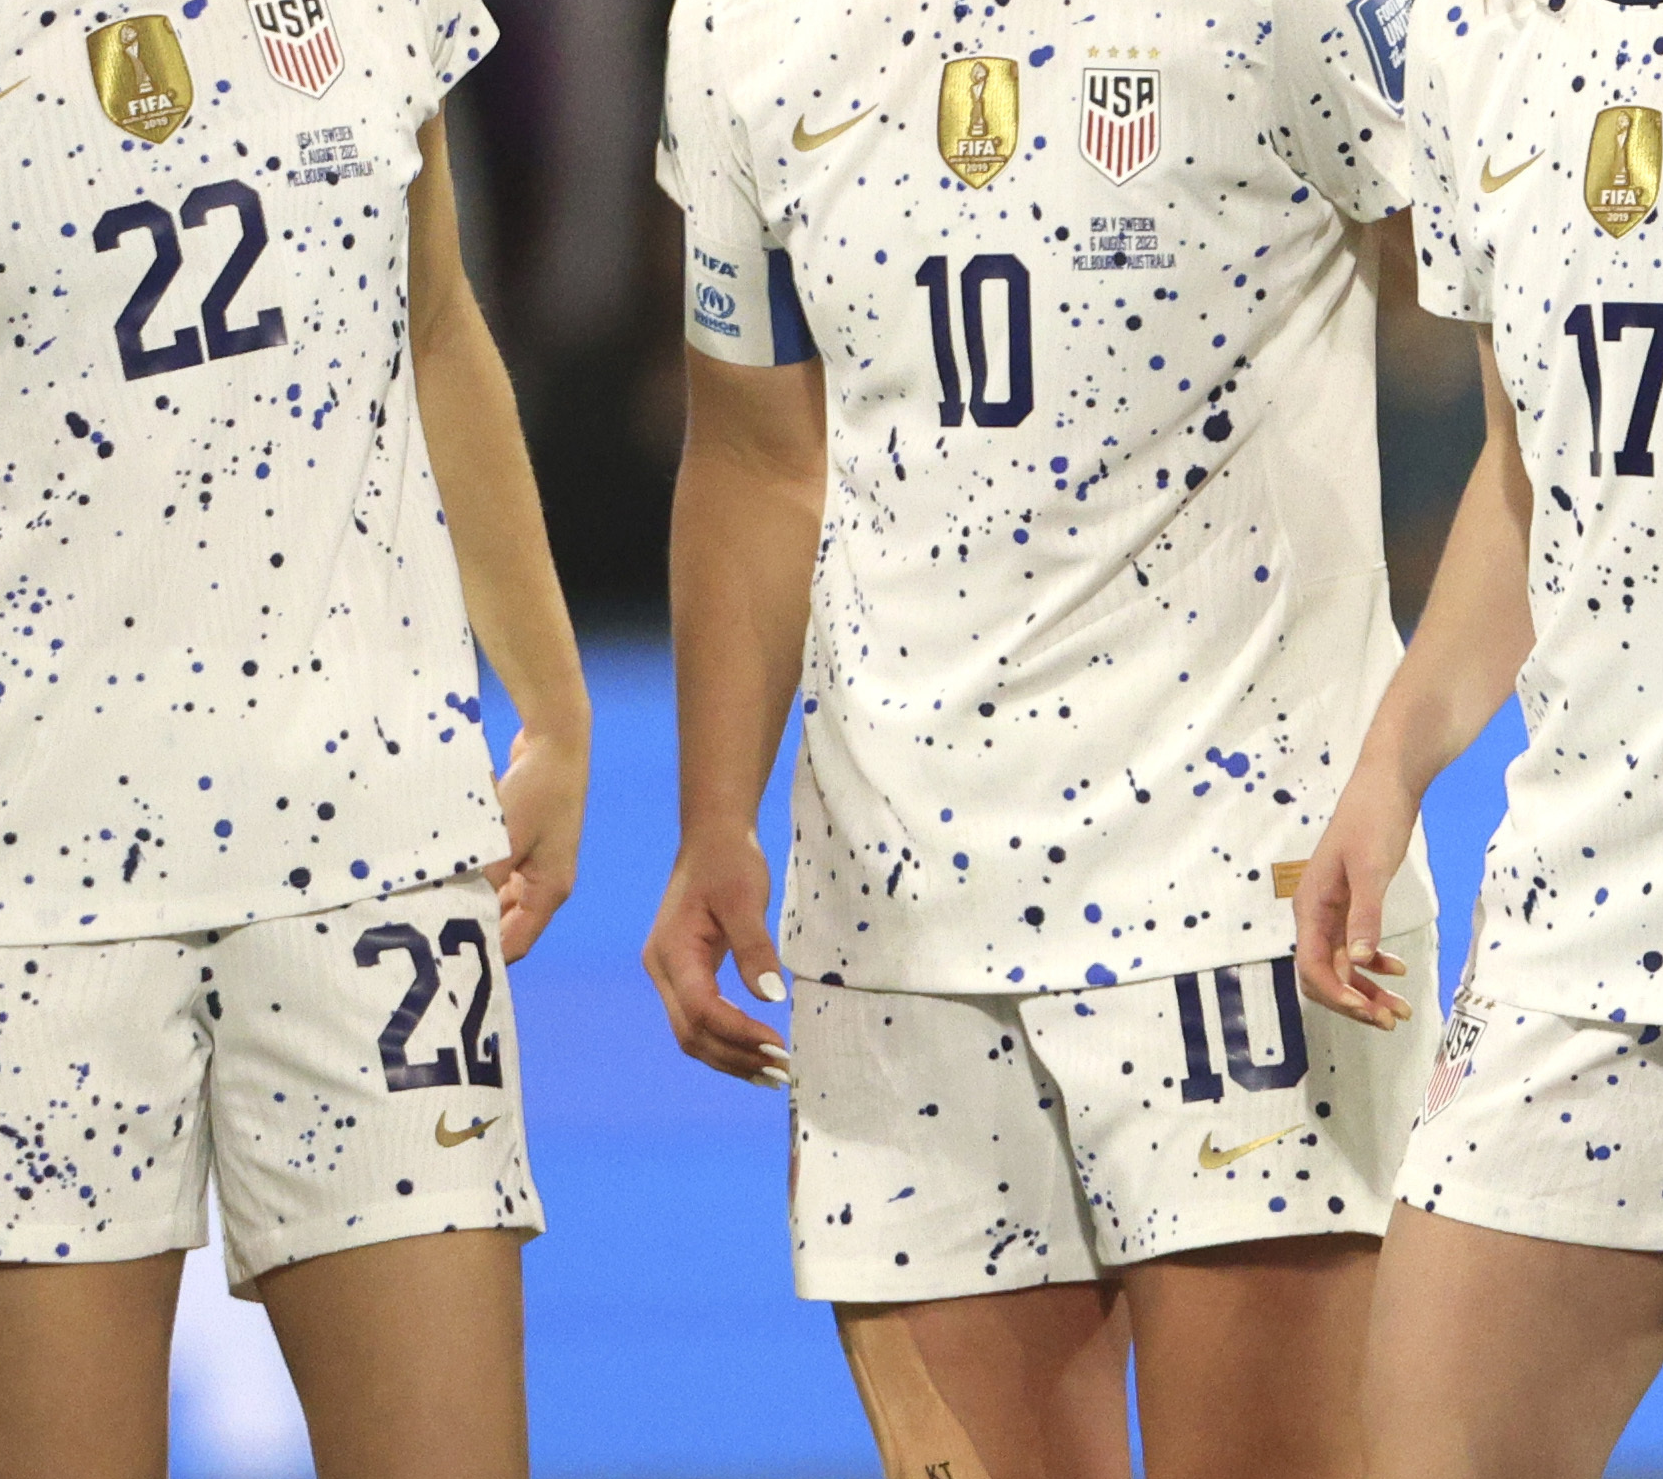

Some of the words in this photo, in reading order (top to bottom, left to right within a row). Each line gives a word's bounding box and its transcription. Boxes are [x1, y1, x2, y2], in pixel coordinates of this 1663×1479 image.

[128, 93, 173, 116] FIFA
[1090, 75, 1154, 118] USA
[958, 140, 996, 155] FIFA
[287, 167, 332, 189] MELBOURN
[1601, 189, 1637, 205] FIFA
[1135, 235, 1158, 250] 2023
[694, 246, 738, 278] FIFA
[1073, 255, 1122, 271] MELBOURN
[93, 178, 288, 382] 22
[915, 254, 1035, 427] 10
[353, 918, 503, 1093] 22
[1175, 957, 1309, 1104] 10
[1446, 1018, 1481, 1061] USA
